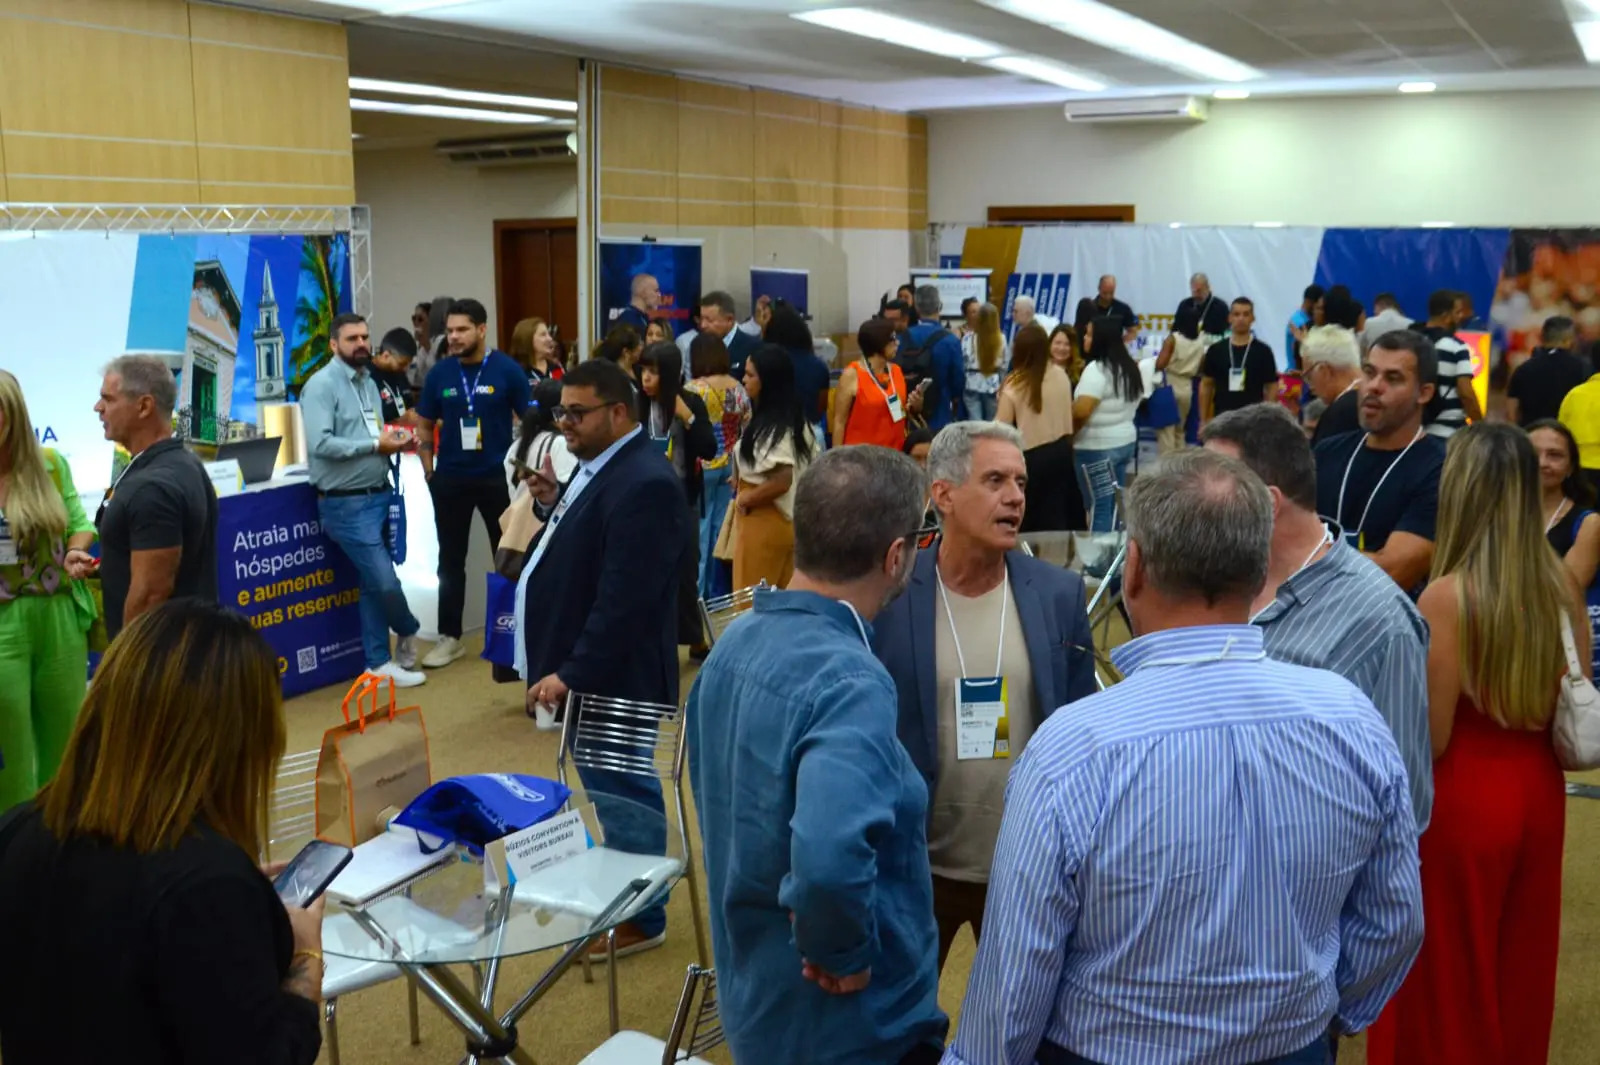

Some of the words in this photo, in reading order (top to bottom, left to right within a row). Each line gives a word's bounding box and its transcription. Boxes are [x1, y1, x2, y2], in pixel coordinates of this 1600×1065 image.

[233, 524, 289, 553] Atraia
[235, 545, 326, 580] hóspedes
[237, 589, 250, 607] e
[254, 568, 335, 603] aumente
[250, 607, 284, 630] uas
[287, 587, 361, 621] reservas
[517, 841, 548, 859] VISITORS
[548, 830, 574, 849] BUREAU
[531, 819, 574, 841] CONVENTION
